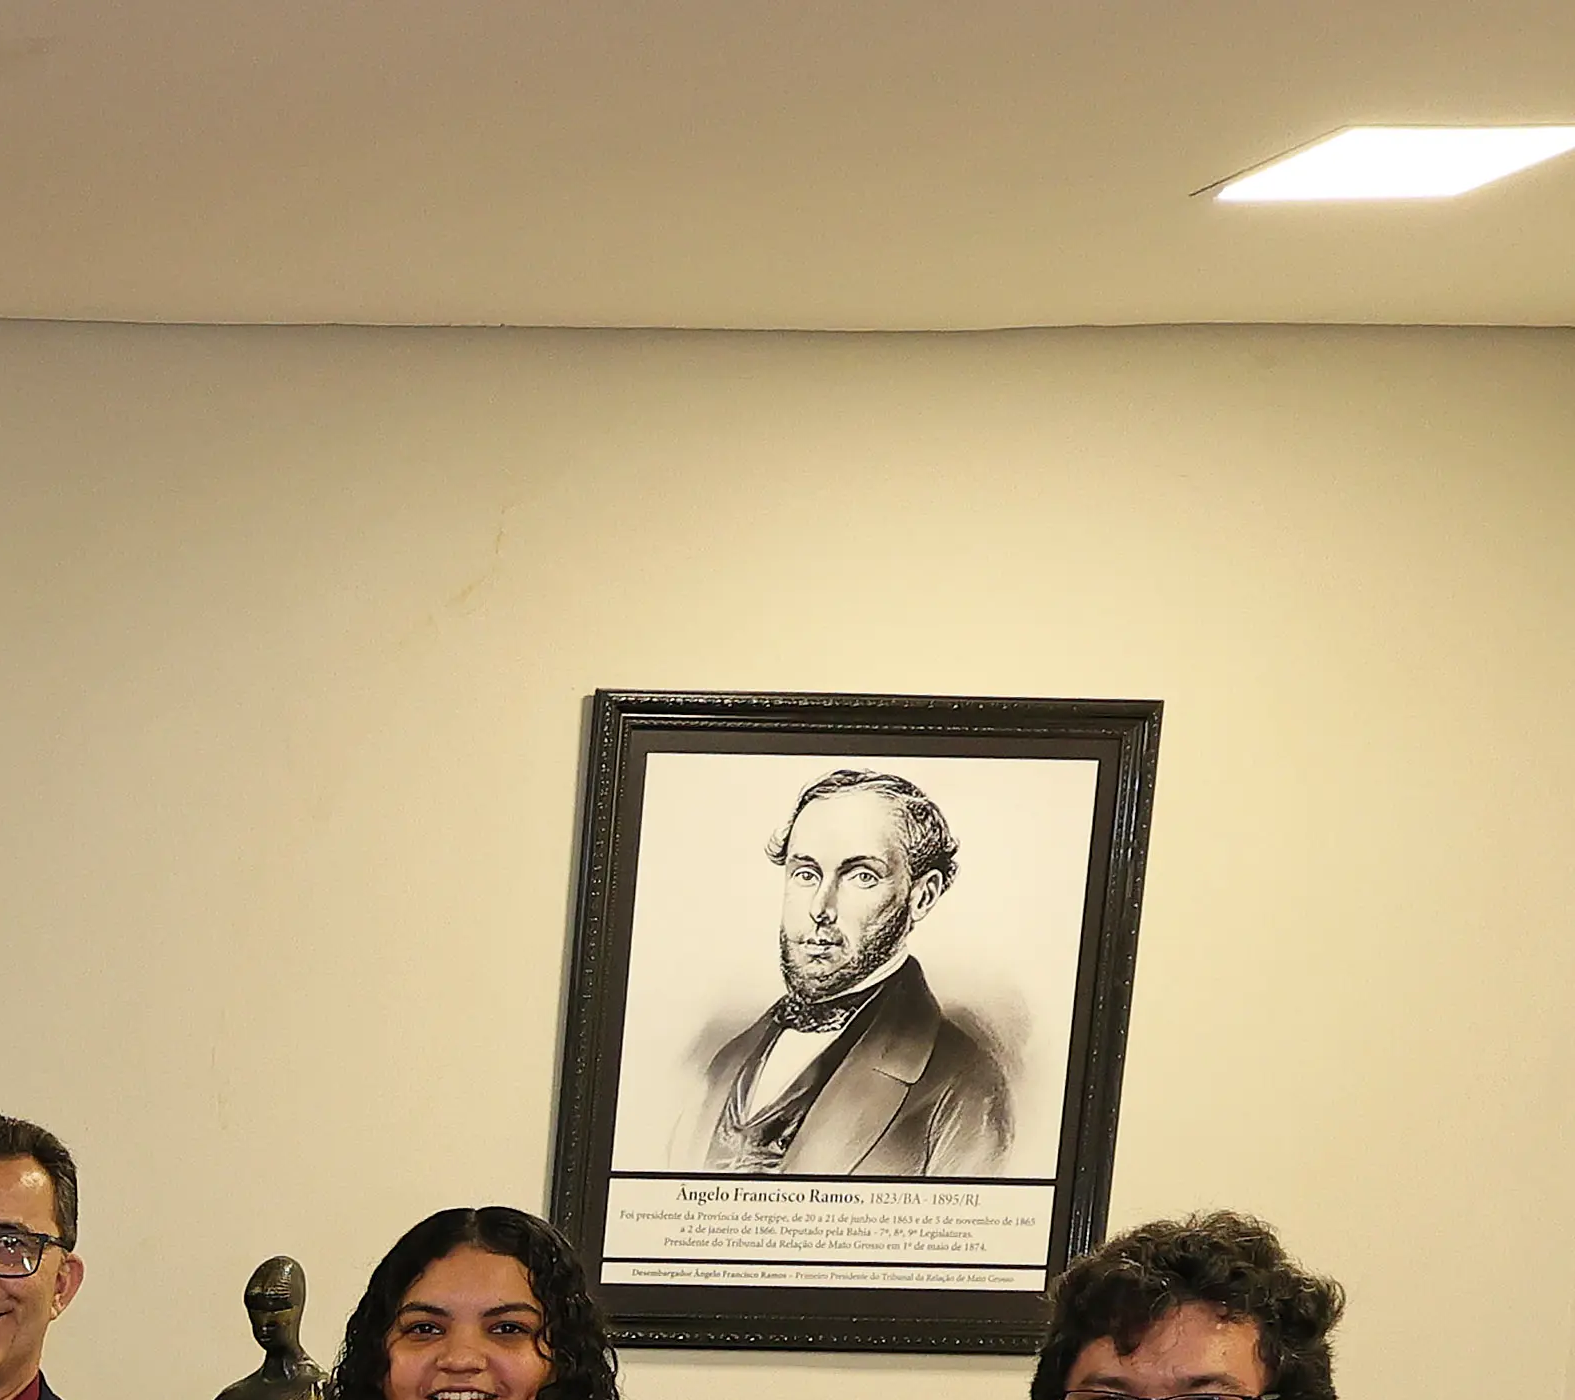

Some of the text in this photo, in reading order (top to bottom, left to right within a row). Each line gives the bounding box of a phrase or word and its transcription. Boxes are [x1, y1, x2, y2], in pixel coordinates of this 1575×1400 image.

[677, 1185, 729, 1206] Ângelo
[734, 1188, 805, 1202] Francisco
[809, 1189, 864, 1203] Ramos,
[870, 1192, 920, 1204] 1823/BA
